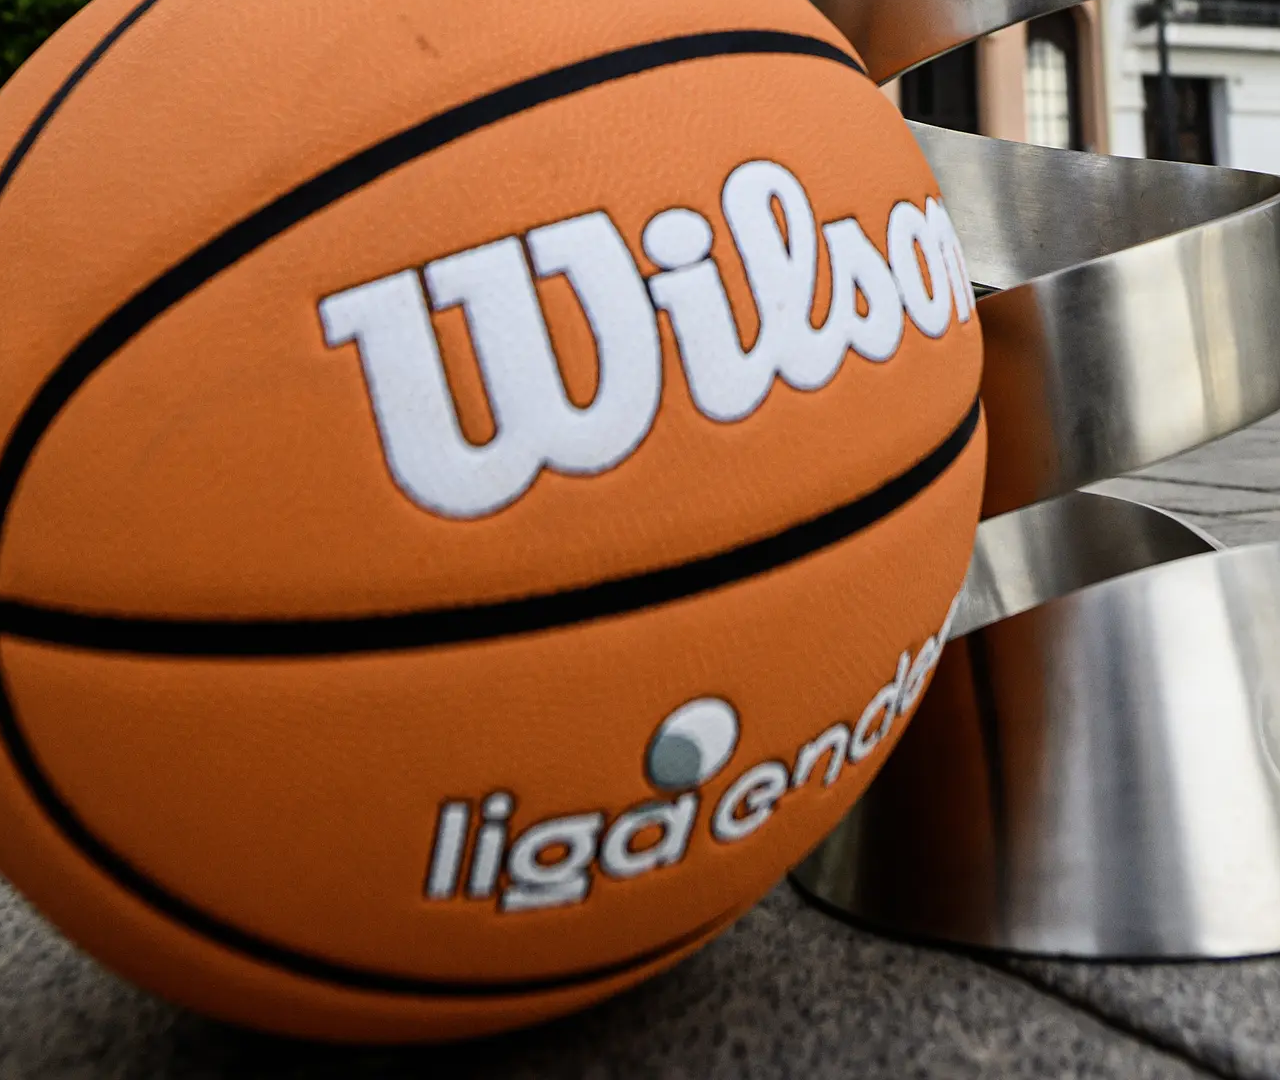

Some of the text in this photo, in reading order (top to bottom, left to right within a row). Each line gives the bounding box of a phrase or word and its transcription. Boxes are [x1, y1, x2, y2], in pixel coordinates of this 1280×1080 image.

[320, 158, 977, 520] Wilson
[425, 588, 966, 913] liga ende
